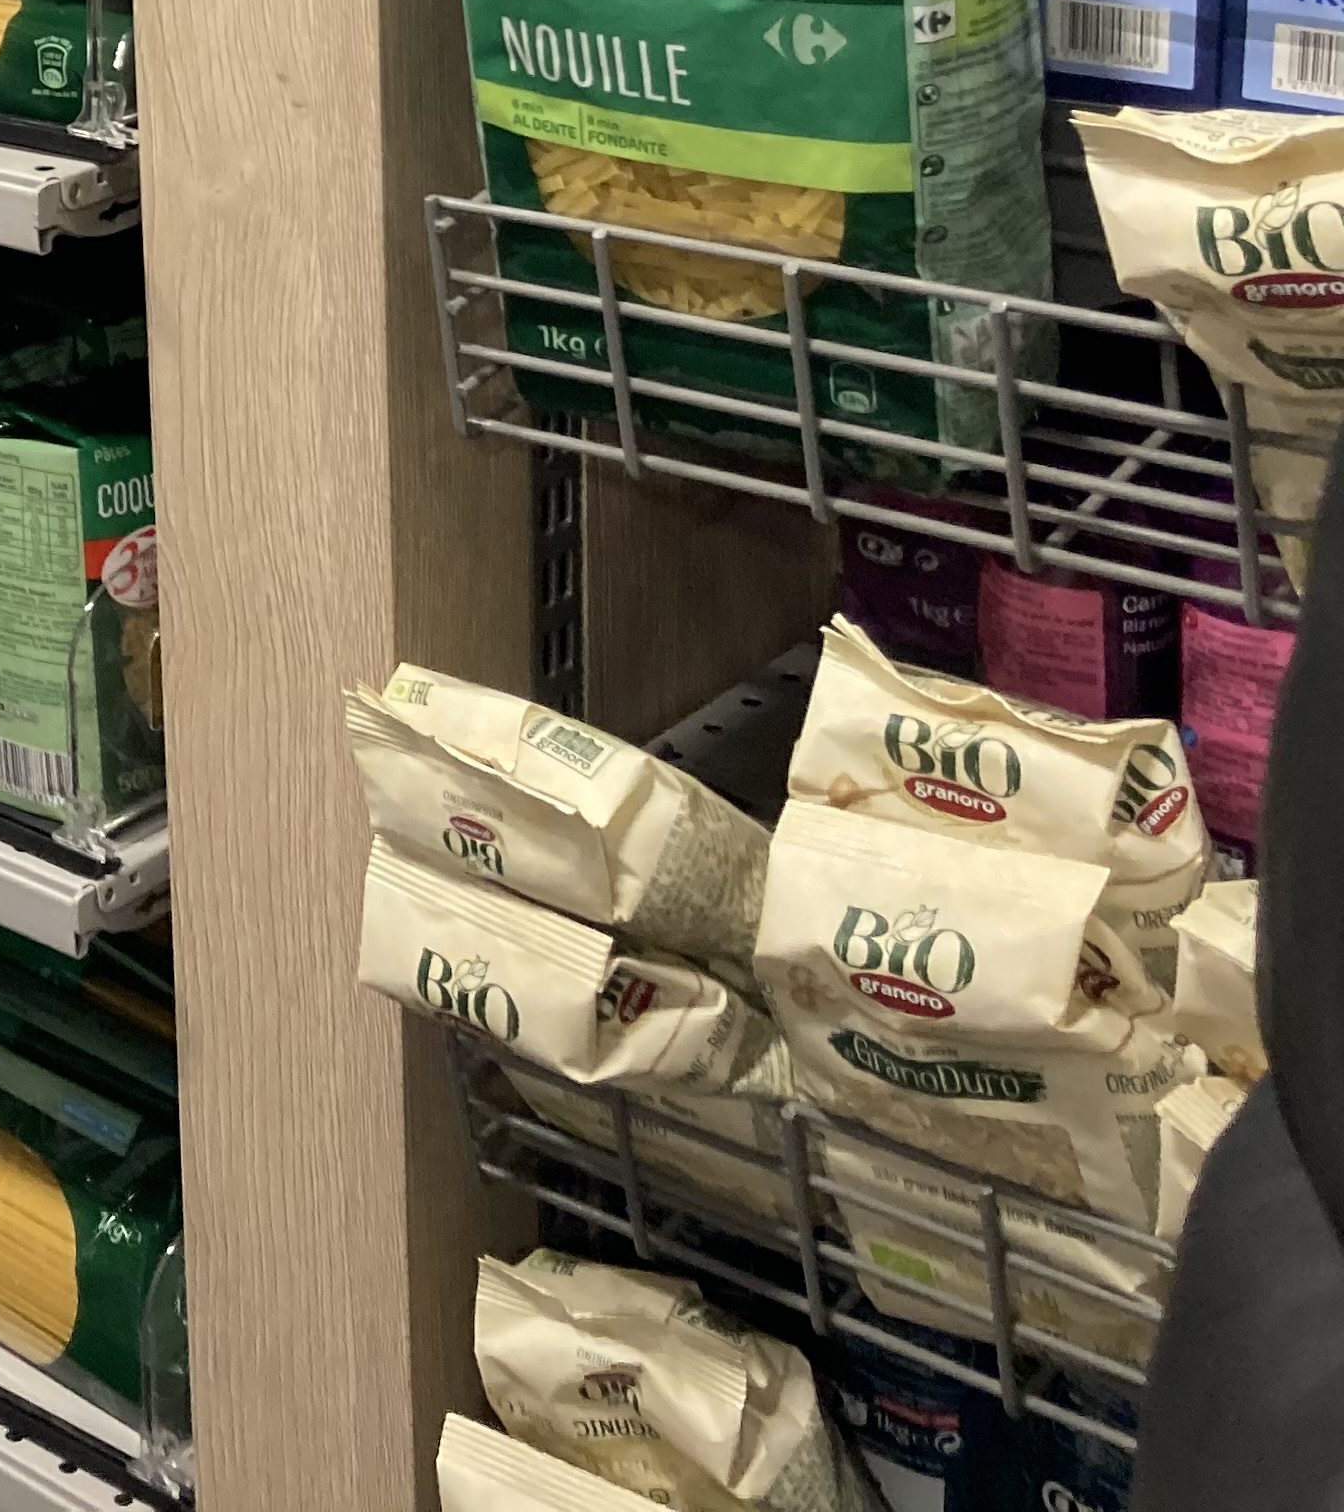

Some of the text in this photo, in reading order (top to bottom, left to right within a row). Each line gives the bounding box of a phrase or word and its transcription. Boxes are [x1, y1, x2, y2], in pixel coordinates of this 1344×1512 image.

[500, 13, 692, 107] NOUILLE
[513, 113, 577, 140] AL DENTE
[587, 129, 669, 158] FONDANTE
[1243, 278, 1343, 304] granoro
[537, 324, 587, 356] 1kg
[534, 737, 592, 771] granoro
[913, 778, 997, 817] granoro
[860, 973, 944, 1011] granoro
